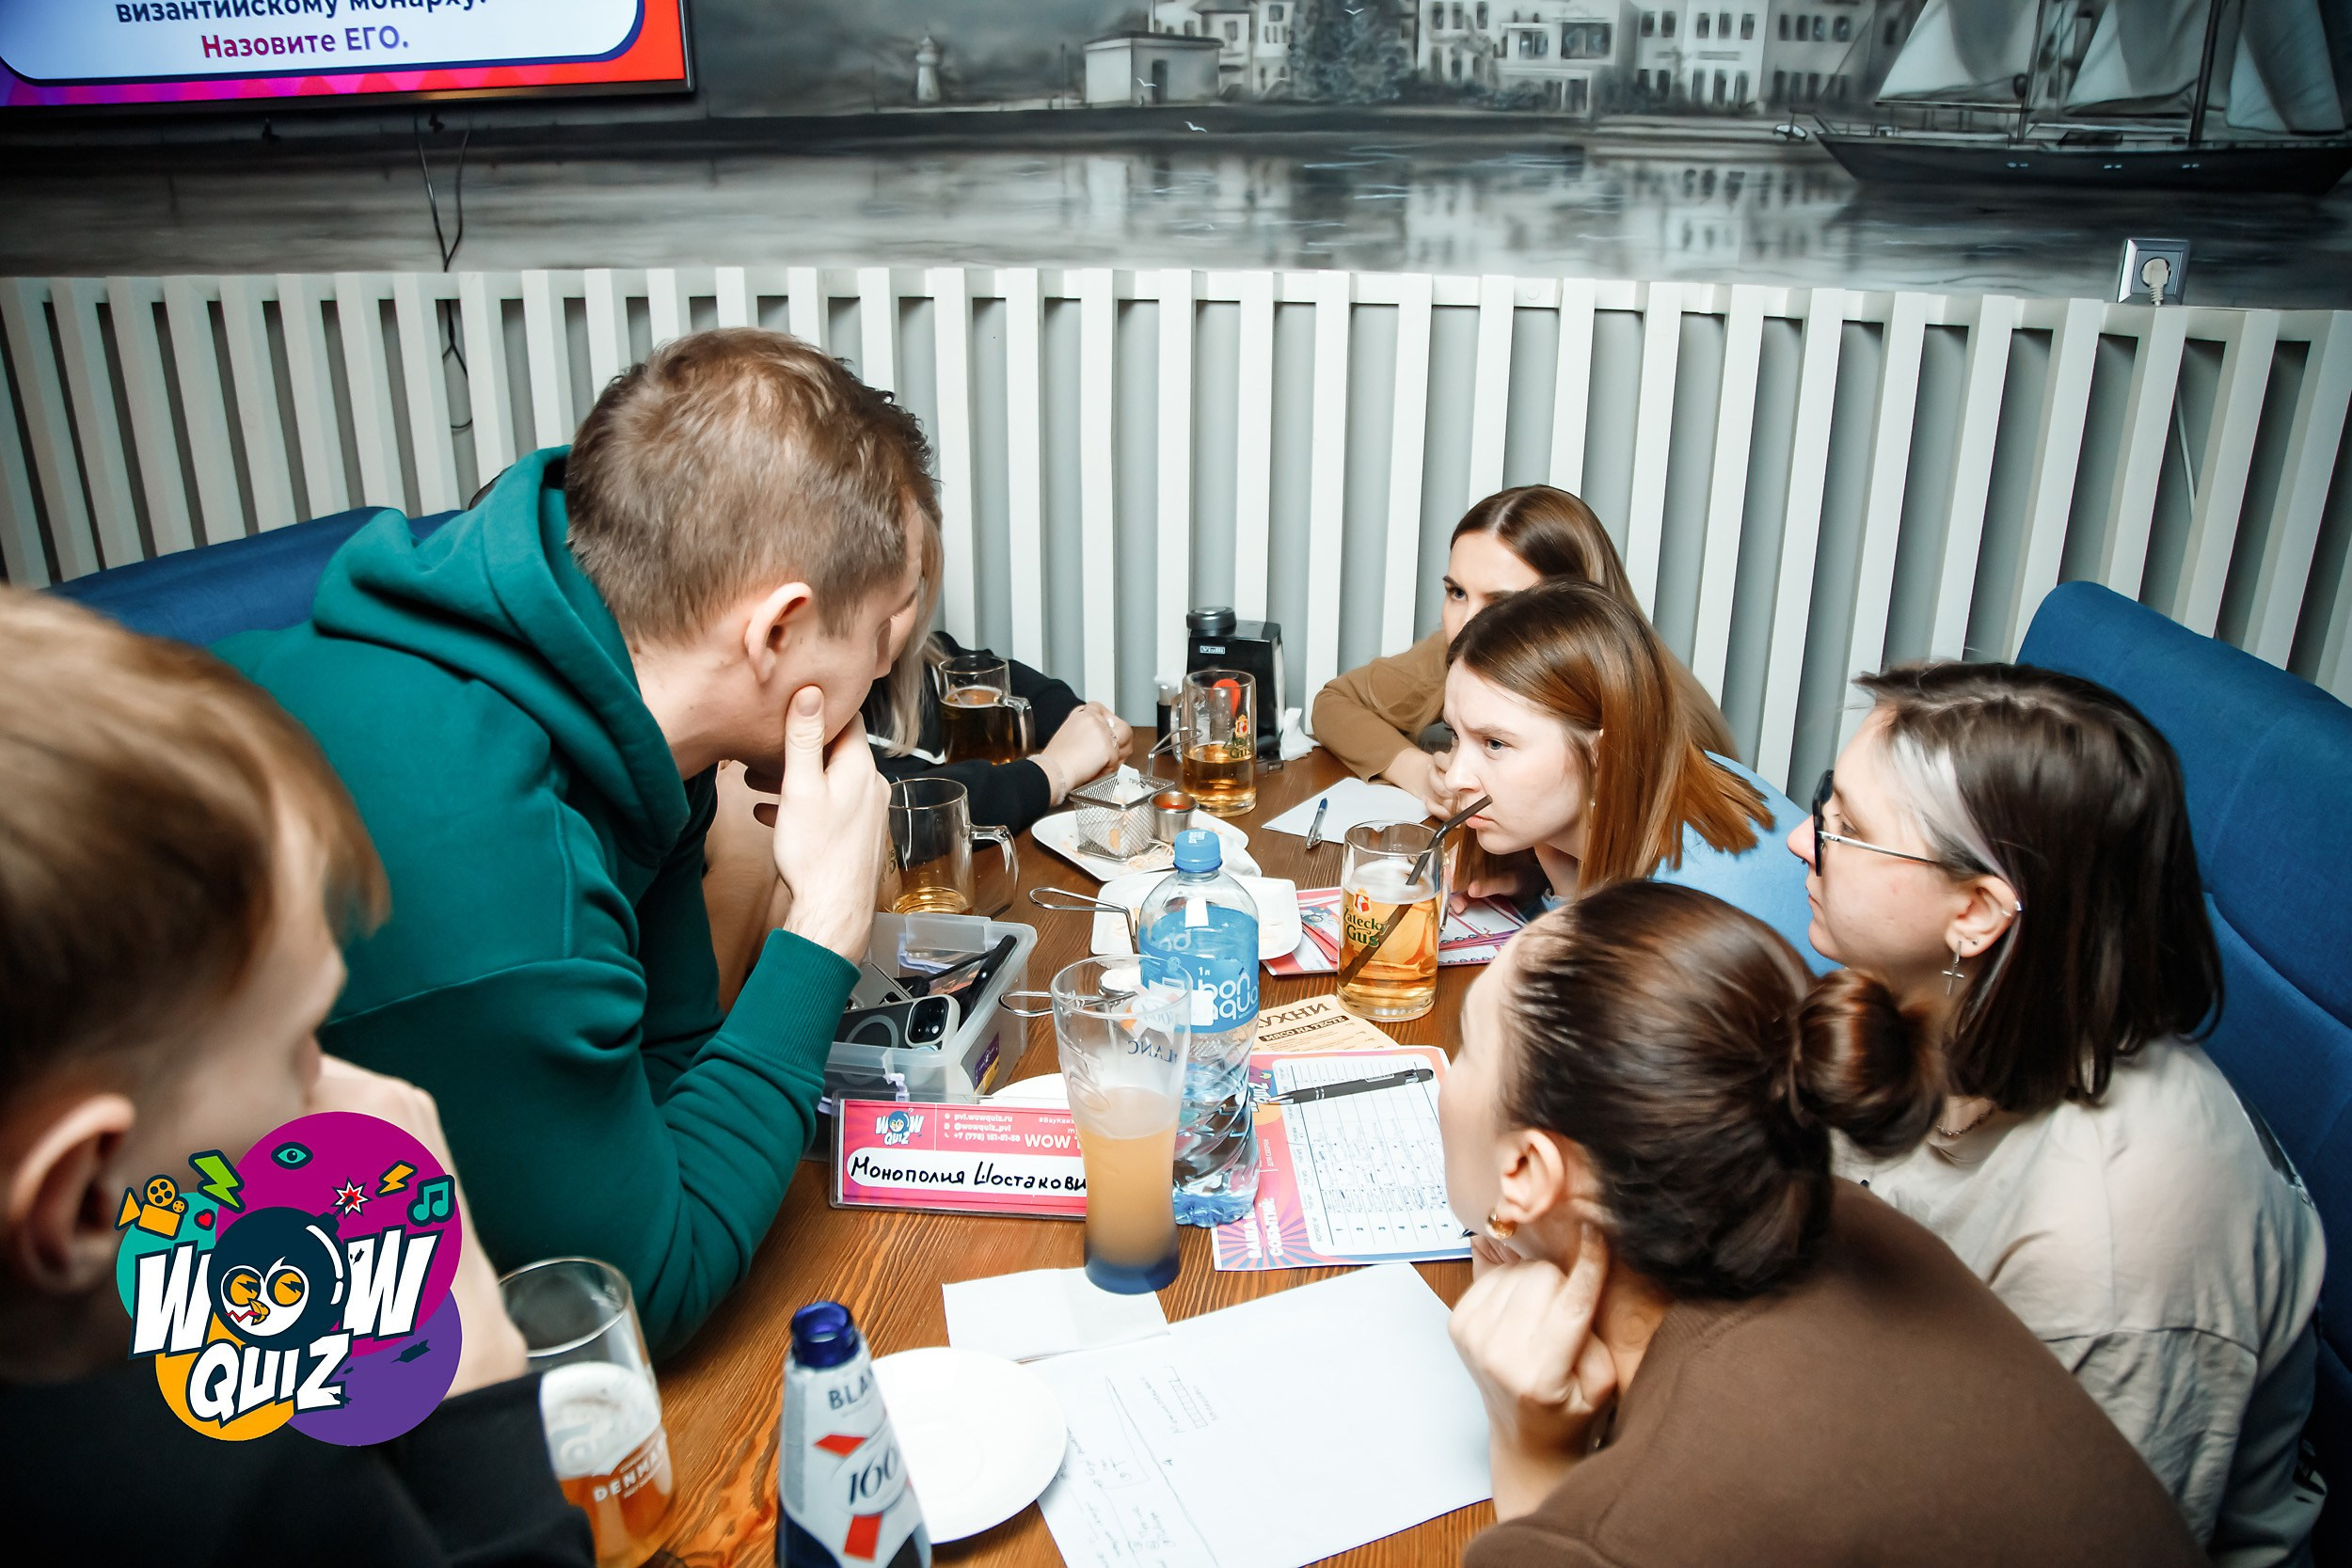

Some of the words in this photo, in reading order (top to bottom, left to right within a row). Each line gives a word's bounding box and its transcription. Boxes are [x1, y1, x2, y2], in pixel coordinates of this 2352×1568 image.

[117, 0, 338, 23] византийскому
[349, 0, 486, 13] монару
[201, 33, 336, 58] Назовите
[345, 25, 408, 51] ЕГО.
[1346, 924, 1379, 948] Gus
[1264, 1027, 1295, 1041] МЯСО
[1295, 1022, 1312, 1035] НА
[875, 1111, 924, 1134] WOW
[883, 1132, 911, 1146] QUIZ
[1025, 1133, 1071, 1148] WOW
[850, 1155, 965, 1184] Монополия
[974, 1161, 1087, 1191] Шостакови
[850, 1446, 898, 1505] 166
